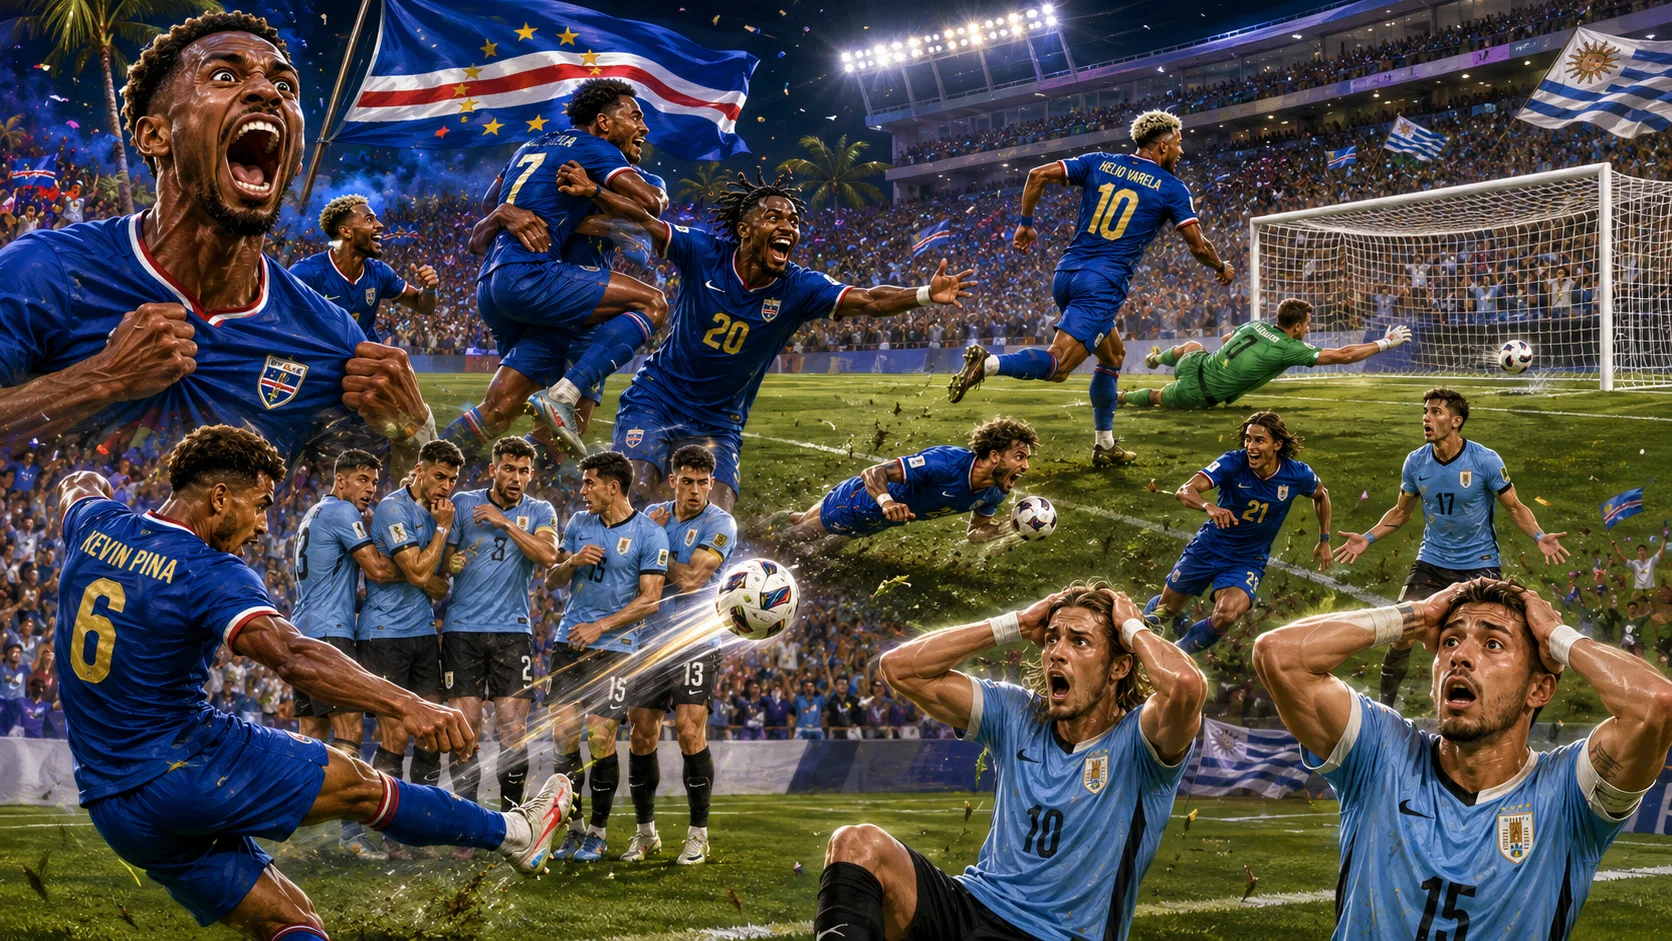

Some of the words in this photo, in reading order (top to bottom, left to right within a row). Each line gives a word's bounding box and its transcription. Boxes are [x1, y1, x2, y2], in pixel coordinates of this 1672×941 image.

[506, 152, 547, 205] 7
[1098, 160, 1127, 178] HELIO
[1126, 168, 1162, 191] VARELA
[1087, 182, 1139, 241] 10
[702, 312, 750, 355] 20
[1241, 500, 1269, 524] 21
[1436, 492, 1455, 515] 17
[80, 530, 133, 569] KEVIN
[128, 549, 178, 584] PINA
[70, 577, 126, 684] 6
[521, 655, 532, 681] 2
[608, 676, 627, 702] 15
[683, 661, 704, 686] 13
[1023, 805, 1064, 858] 10
[1415, 876, 1477, 941] 15
